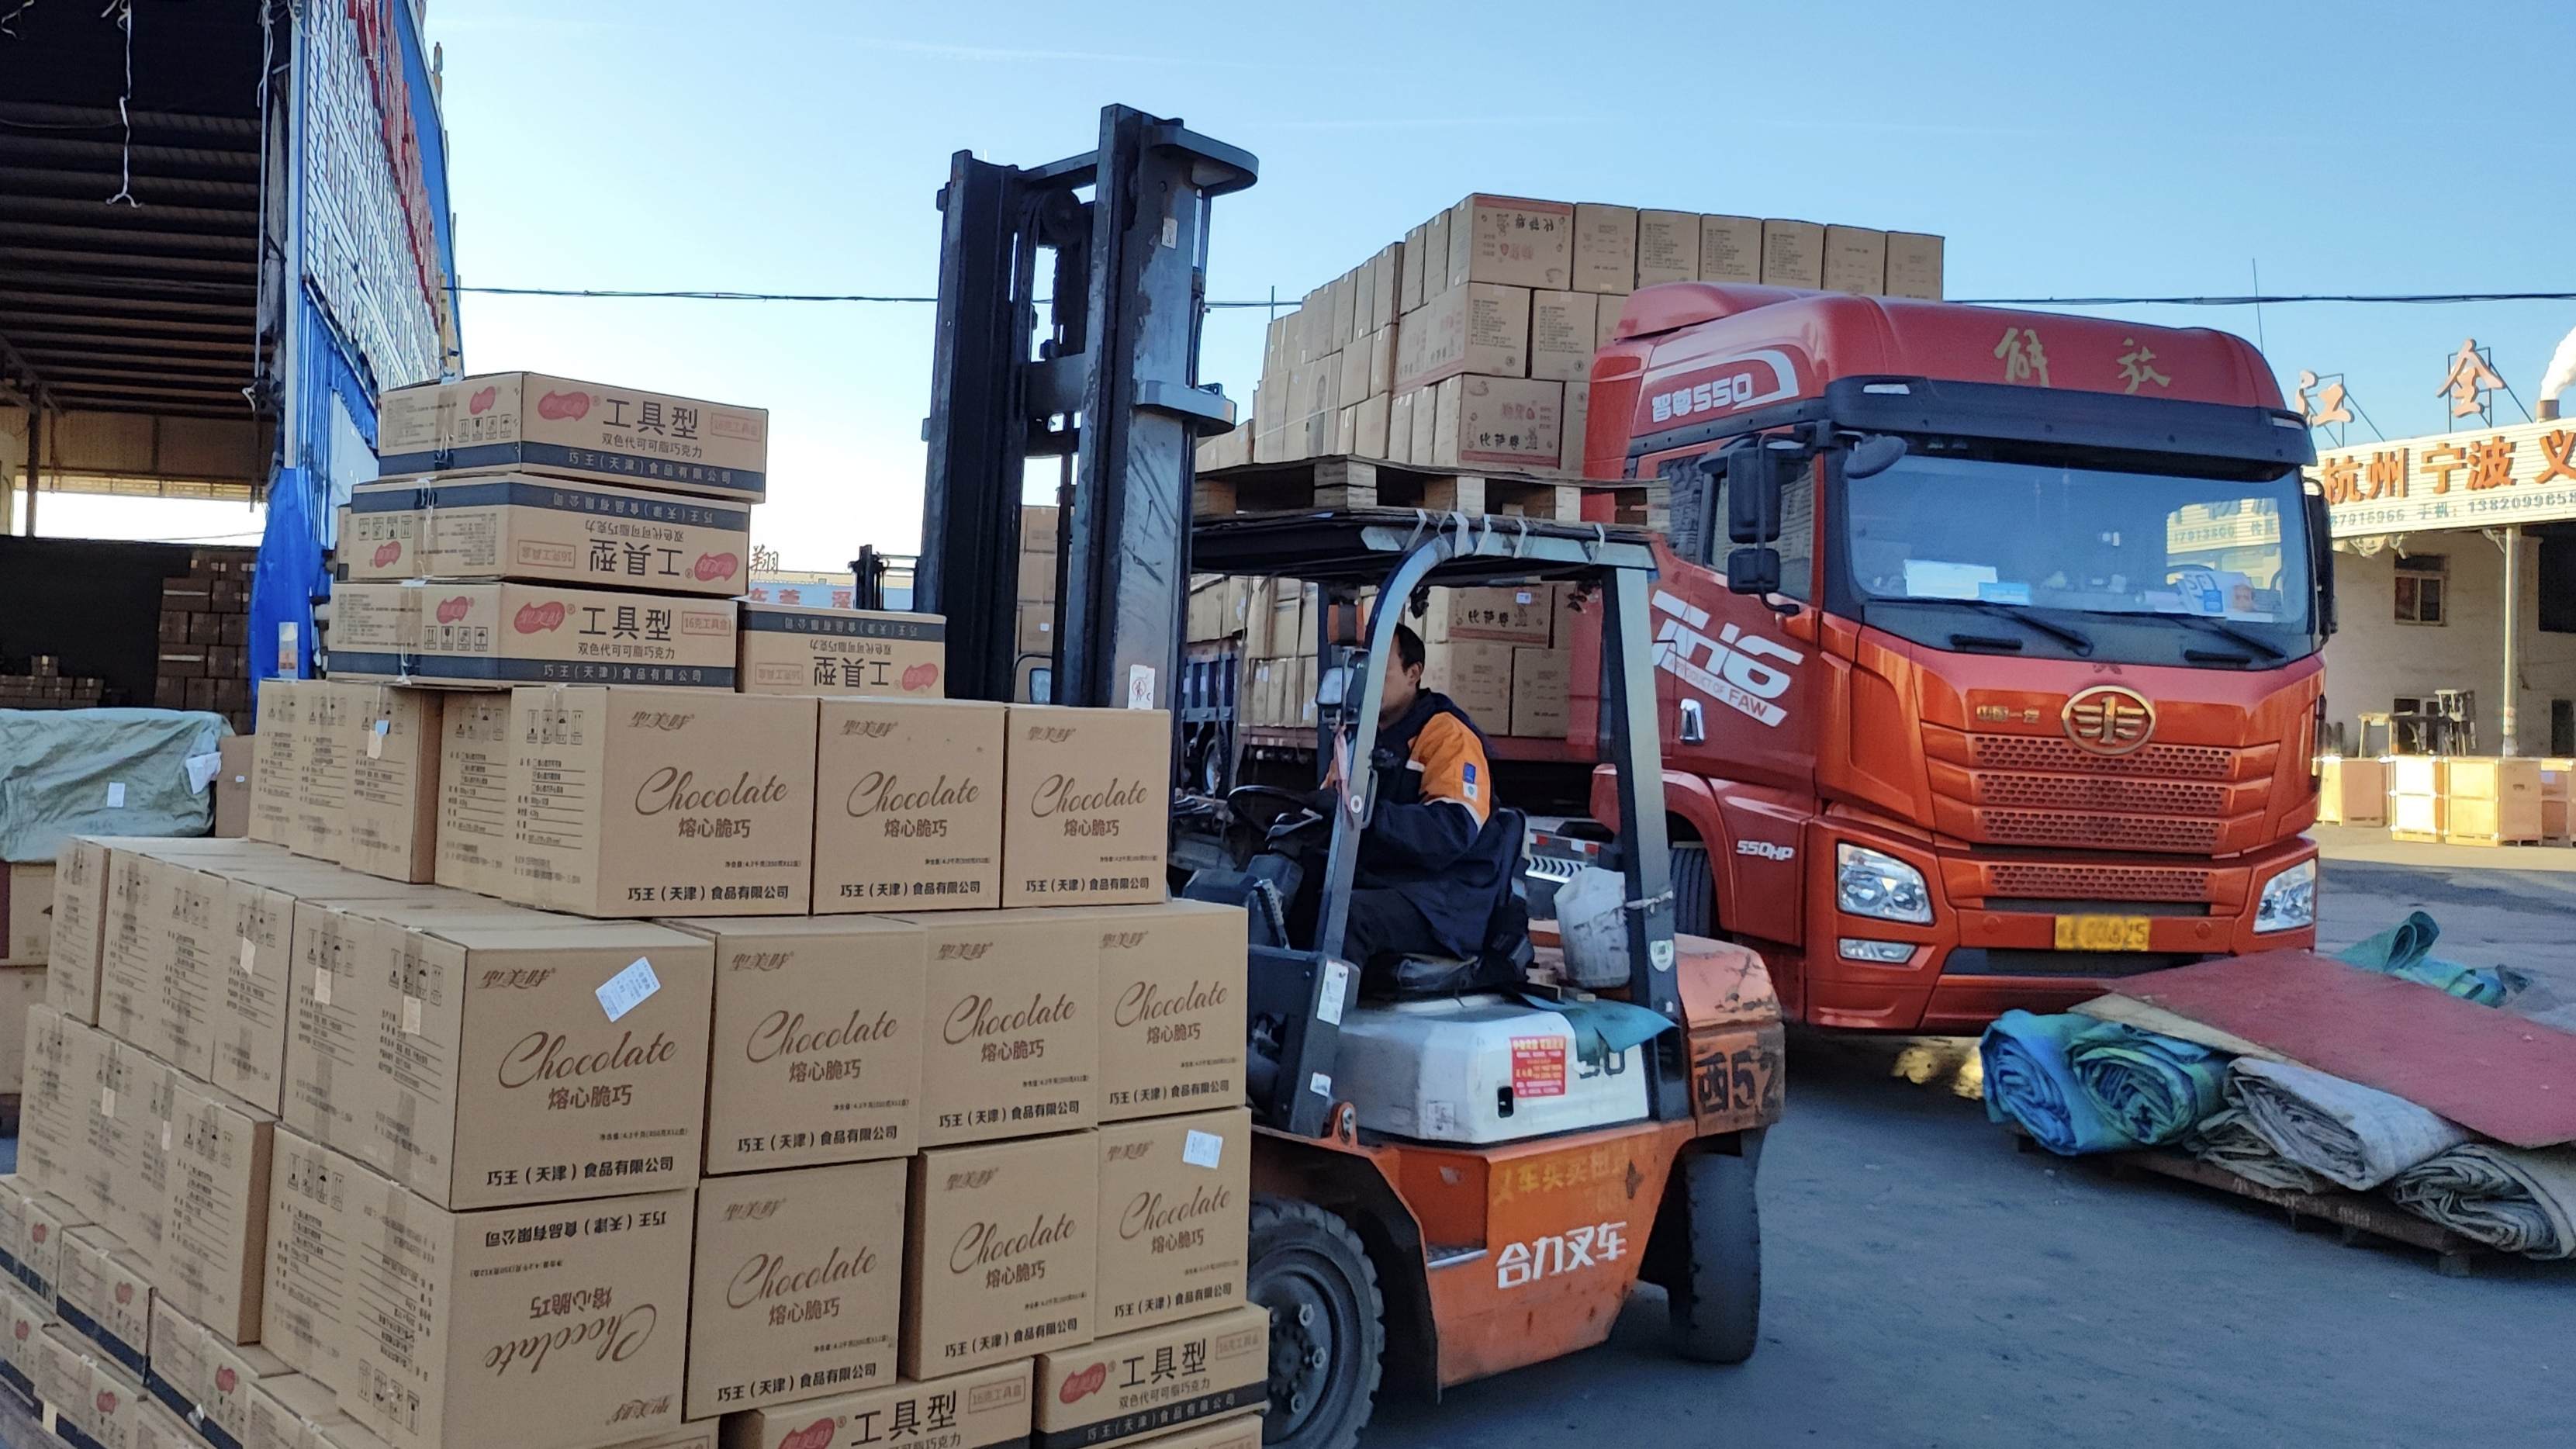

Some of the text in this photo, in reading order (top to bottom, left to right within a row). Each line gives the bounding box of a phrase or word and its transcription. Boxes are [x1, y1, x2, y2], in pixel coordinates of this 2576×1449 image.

[603, 397, 699, 441] 工具型
[2321, 428, 2576, 506] 杭州 宁波 义
[589, 538, 683, 577] 工具型
[749, 544, 780, 575] 翔
[579, 605, 672, 642] 工具型
[577, 642, 676, 659] 双色代可可脂巧克力
[813, 655, 892, 688] 工具型
[1728, 687, 1768, 718] FAW
[634, 766, 788, 817] Chocolate
[846, 770, 980, 818] Chocolate
[1030, 773, 1148, 818] Chocolate
[677, 817, 752, 839] 熔心脆巧
[883, 818, 948, 839] 熔心脆巧
[1063, 818, 1120, 837] 熔心脆巧
[1736, 839, 1796, 861] 550HP
[627, 884, 789, 902] 巧王（天津）食品有限公司
[839, 880, 981, 898] 巧王（天津）食品有限公司
[1025, 877, 1150, 893] 巧王（天津）食品有限公司
[942, 992, 1076, 1046] Chocolate
[1114, 980, 1228, 1028] Chocolate
[746, 1009, 898, 1063] Chocolate
[1146, 1022, 1201, 1045] 熔心脆巧
[497, 1030, 677, 1089] Chocolate
[980, 1039, 1045, 1063] 熔心脆巧
[788, 1058, 862, 1084] 熔心脆巧
[547, 1084, 634, 1111] 熔心脆巧
[939, 1100, 1080, 1129] 巧王（天津）食品有限公司
[737, 1125, 898, 1153] 巧王（天津）食品有限公司
[486, 1156, 674, 1187] 巧王（天津）食品有限公司
[485, 1210, 667, 1248] 巧王（天津）食品有限公司
[1119, 1184, 1231, 1241] Chocolate
[949, 1212, 1077, 1274] Chocolate
[1151, 1228, 1205, 1255] 熔心脆巧
[1495, 1221, 1627, 1289] 合力叉车
[726, 1245, 879, 1309] Chocolate
[985, 1260, 1046, 1290] 熔心脆巧
[530, 1286, 613, 1319] 熔心脆巧
[768, 1296, 841, 1328] 熔心脆巧
[485, 1303, 657, 1377] Chocolate
[945, 1317, 1078, 1358] 巧王（天津）食品有限公司
[1119, 1337, 1207, 1389] 工具型
[717, 1362, 877, 1402] 巧王（天津）食品有限公司
[850, 1388, 956, 1448] 工具型
